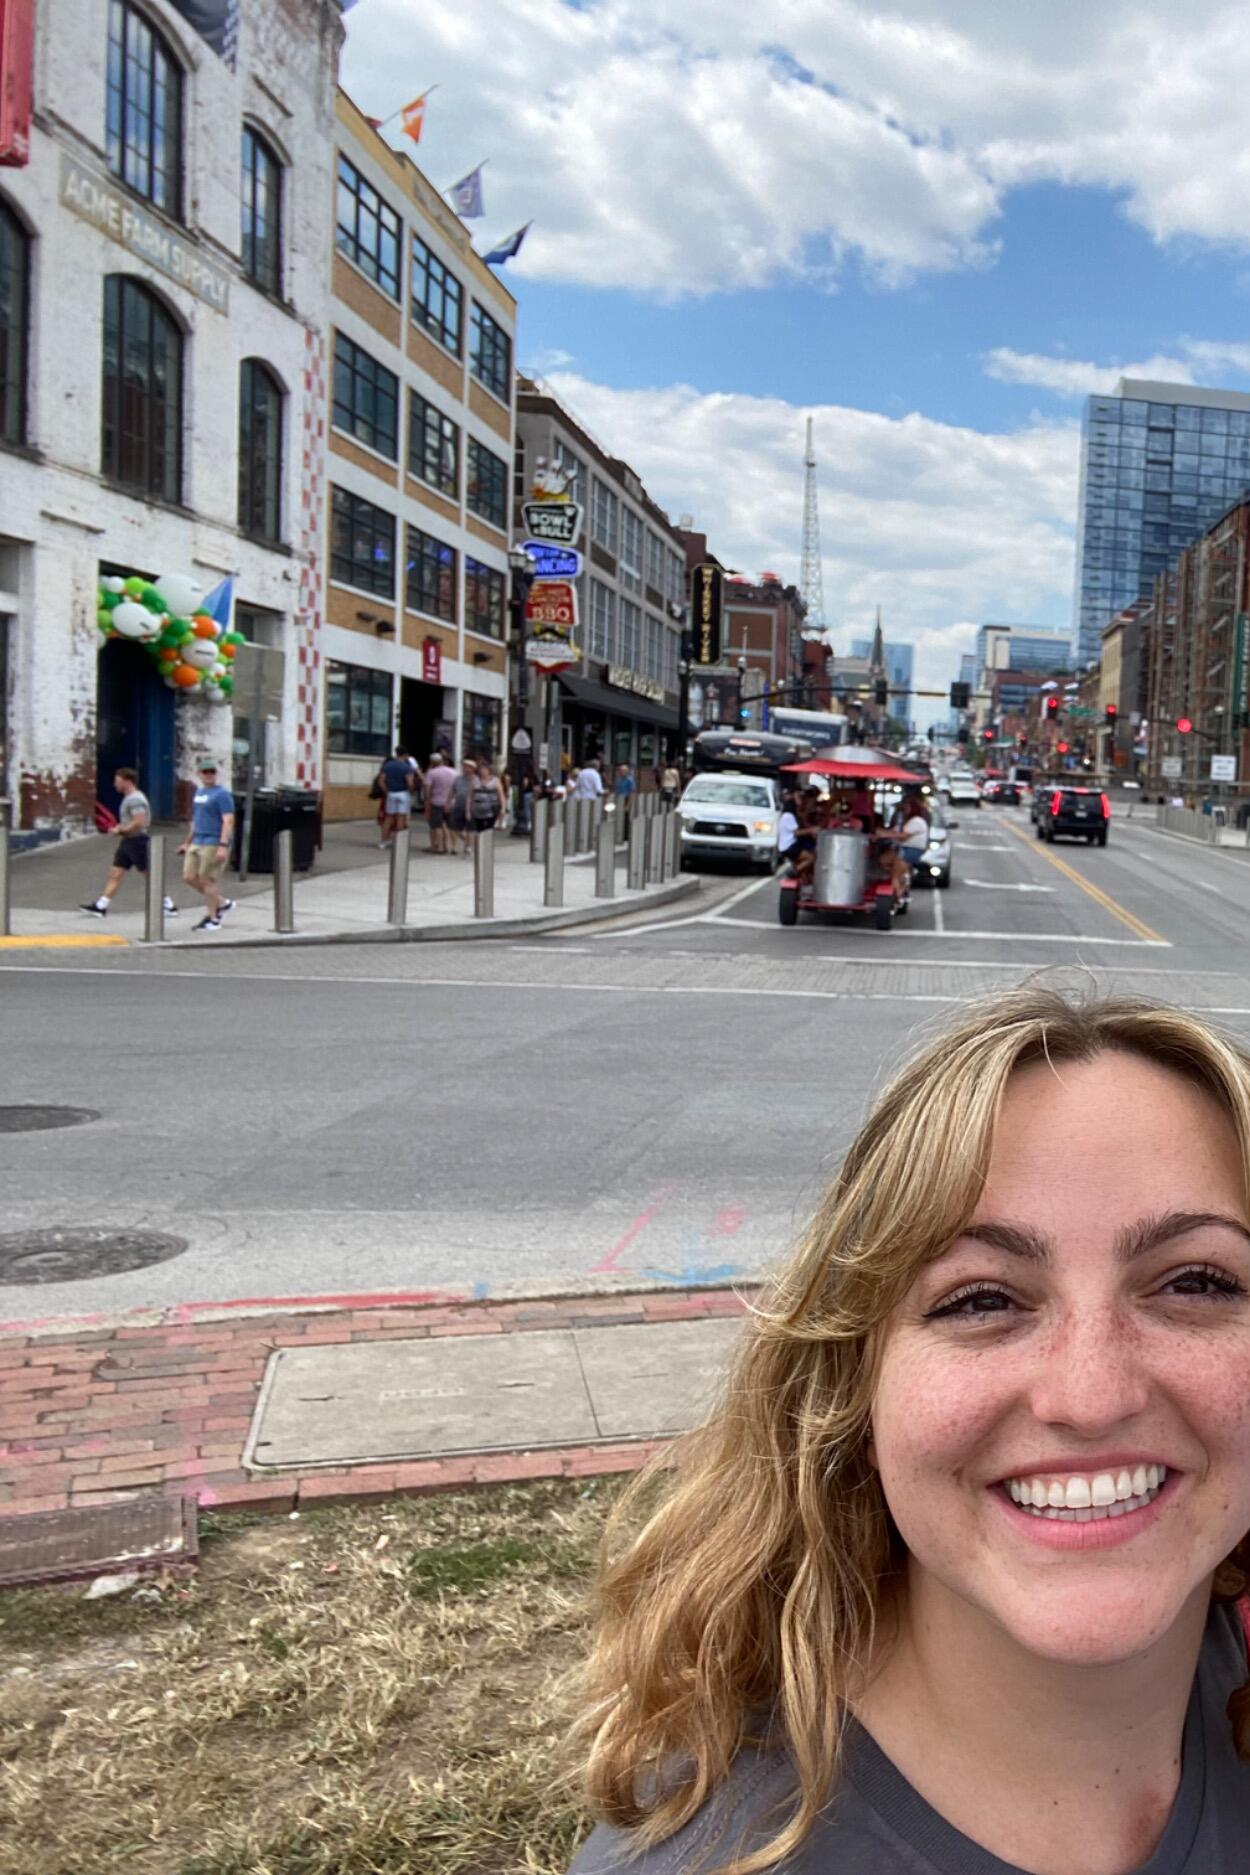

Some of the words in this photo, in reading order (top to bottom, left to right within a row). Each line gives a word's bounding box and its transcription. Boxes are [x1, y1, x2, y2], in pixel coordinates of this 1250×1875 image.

[64, 168, 121, 230] ACME
[122, 208, 171, 263] FARM
[172, 245, 230, 307] SUPPLY
[529, 512, 573, 528] BOWL
[540, 526, 572, 538] BULL
[532, 606, 571, 620] BBQ
